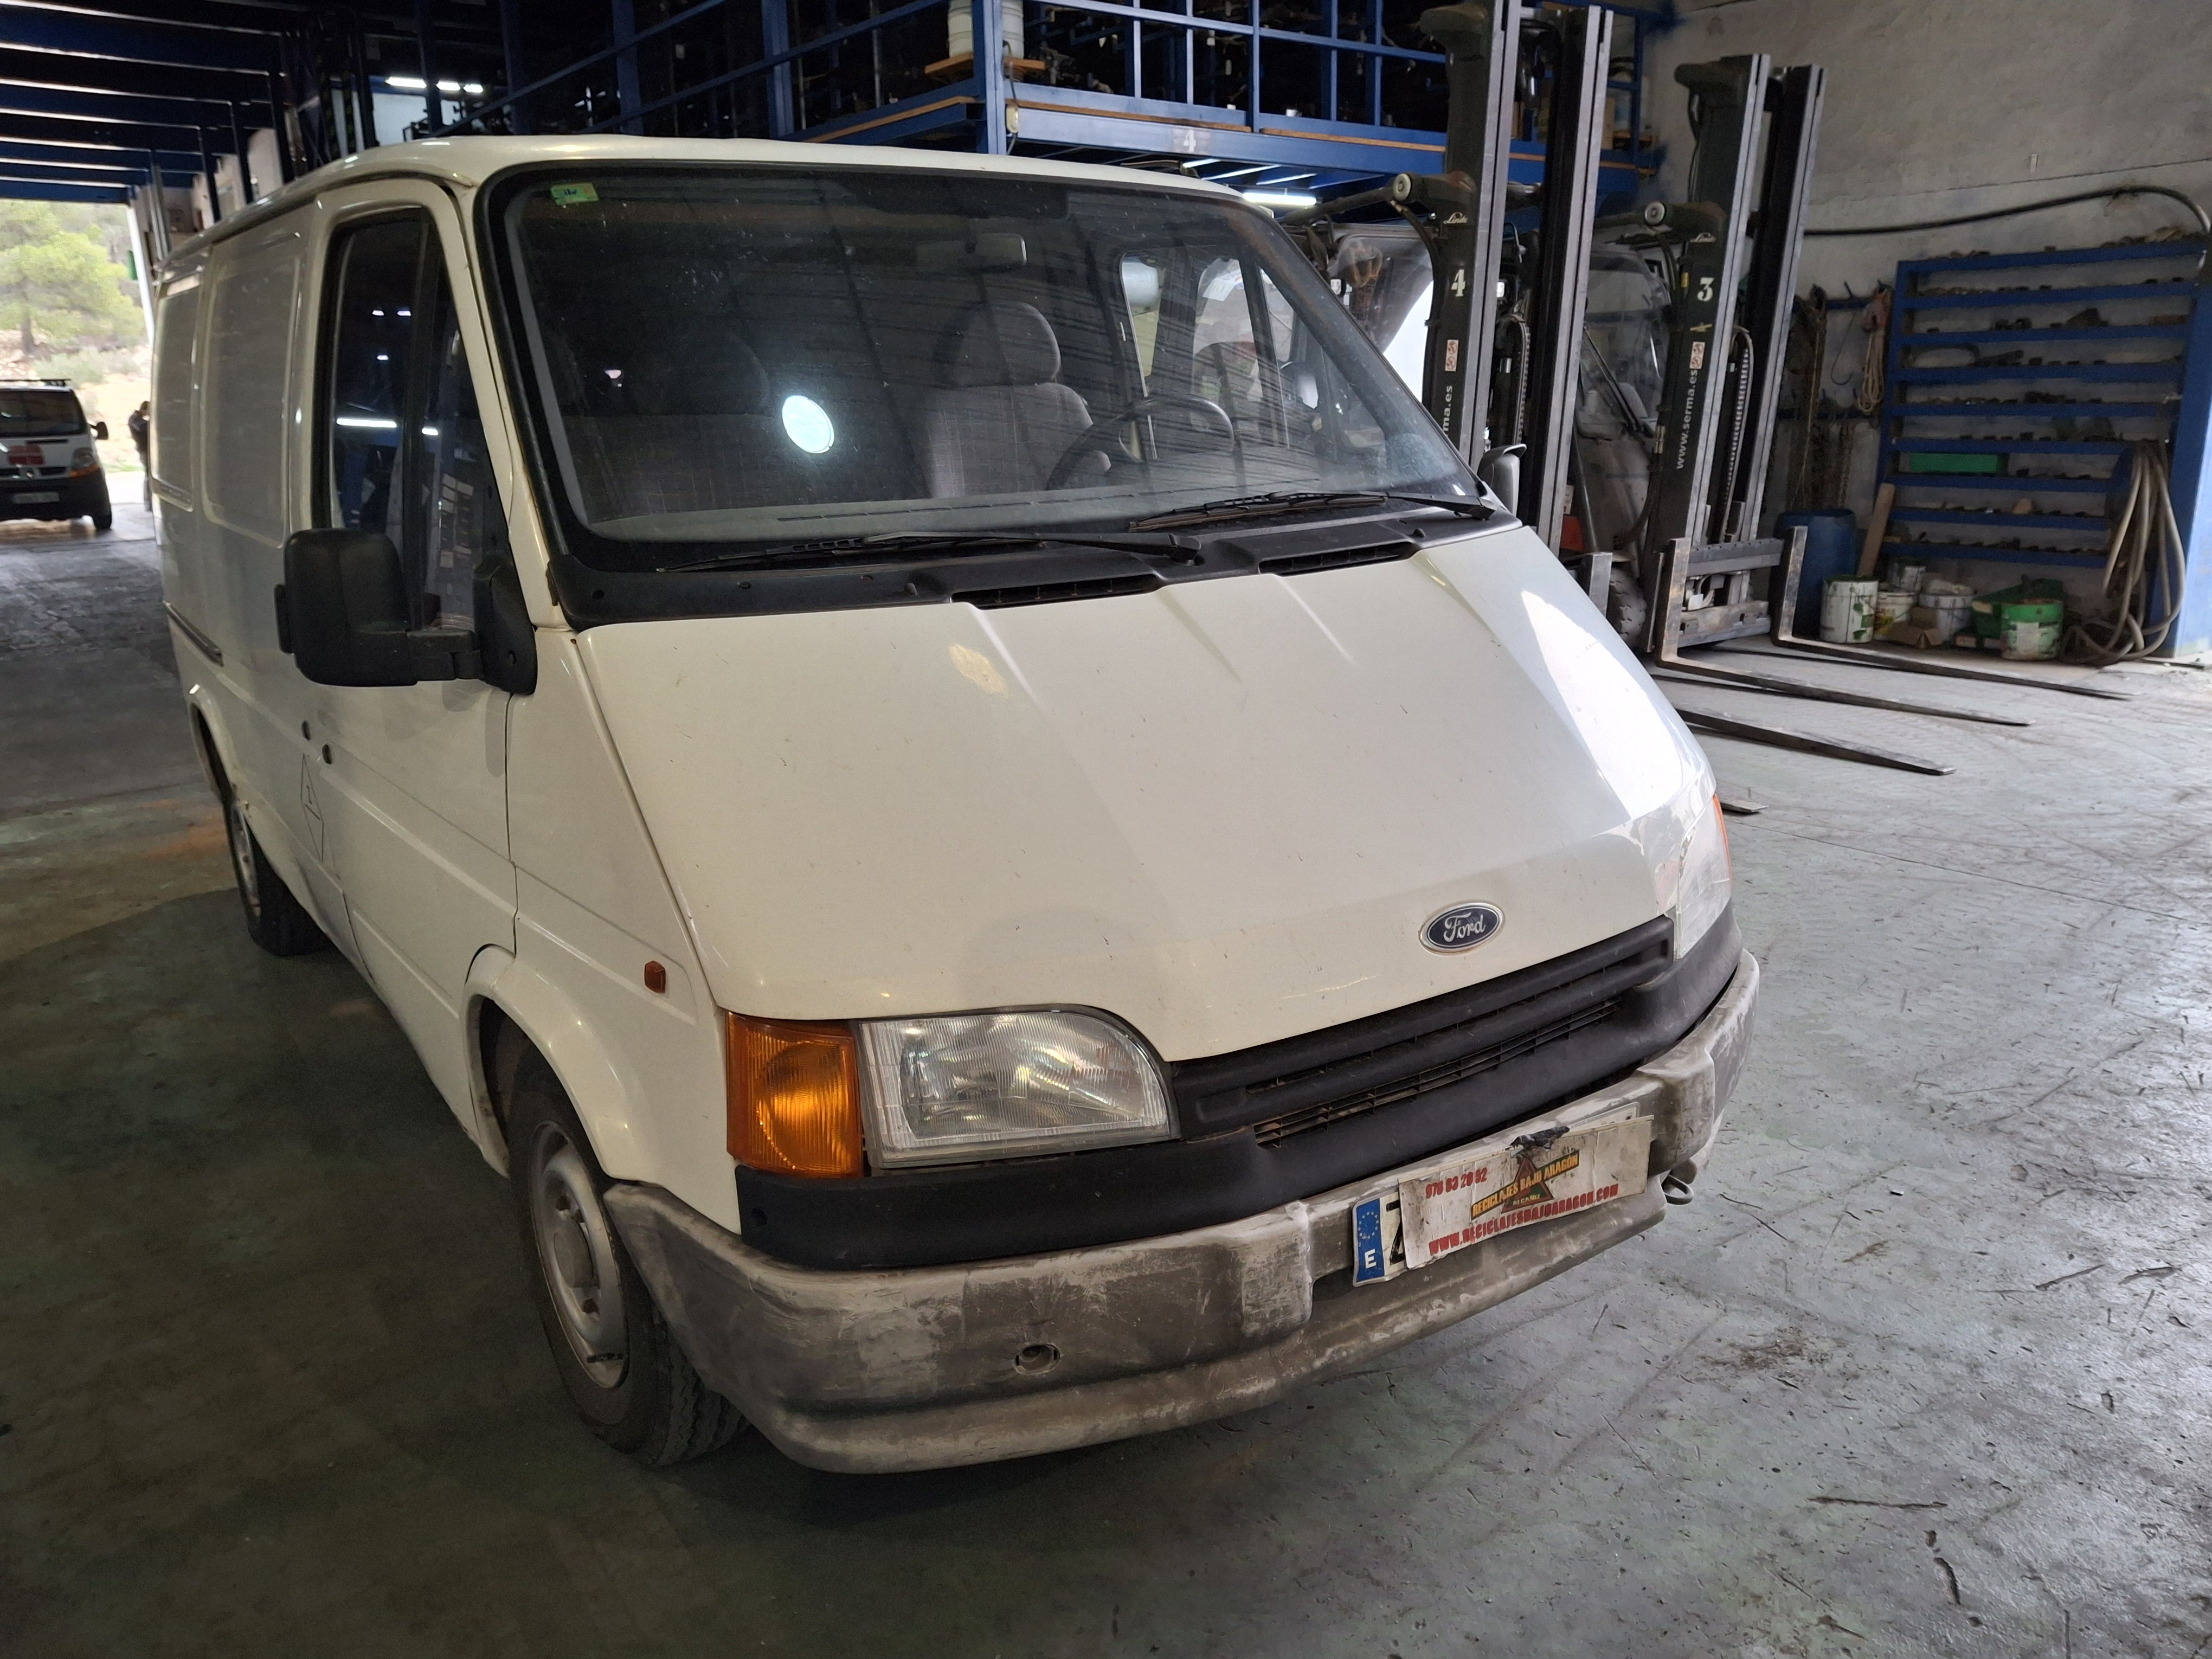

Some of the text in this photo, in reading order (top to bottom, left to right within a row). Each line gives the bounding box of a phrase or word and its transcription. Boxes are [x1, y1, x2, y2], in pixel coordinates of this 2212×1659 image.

[1183, 130, 1196, 152] 4
[1451, 269, 1465, 297] 4
[1697, 277, 1714, 301] 3
[1443, 385, 1452, 432] ma.es
[1677, 370, 1697, 469] www.serma.es
[1443, 912, 1486, 942] Ford
[1426, 1167, 1487, 1199] 978 83 20 52
[1472, 1154, 1578, 1217] RECICLAJES BAJO ARAGÓN
[1429, 1184, 1618, 1256] WWW.RECICLAJESBAJOARAGON.COM
[1365, 1249, 1377, 1269] E
